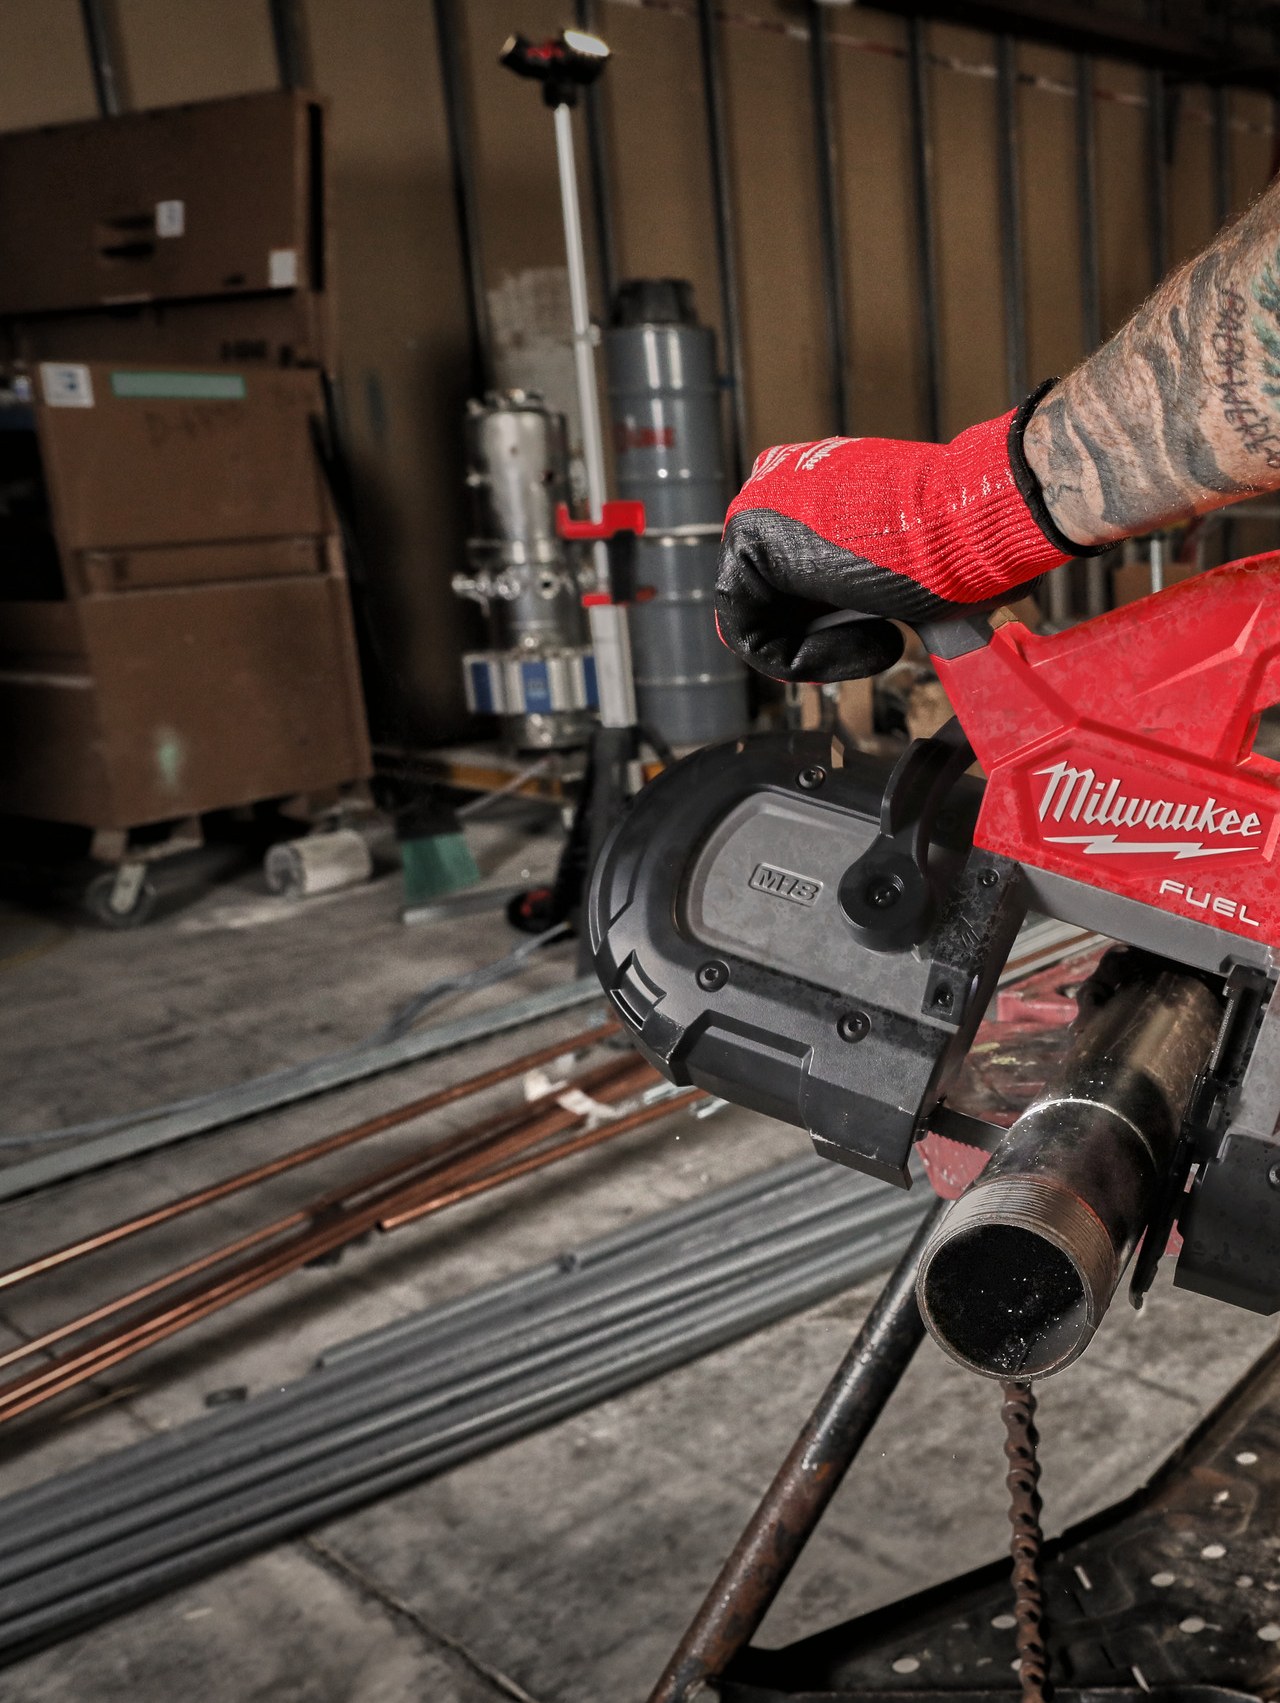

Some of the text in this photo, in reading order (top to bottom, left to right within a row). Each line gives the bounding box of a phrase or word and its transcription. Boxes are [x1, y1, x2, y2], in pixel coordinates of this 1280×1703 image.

[1032, 760, 1262, 837] Milwaukee
[753, 868, 820, 901] M18
[1159, 879, 1261, 927] FUEL
